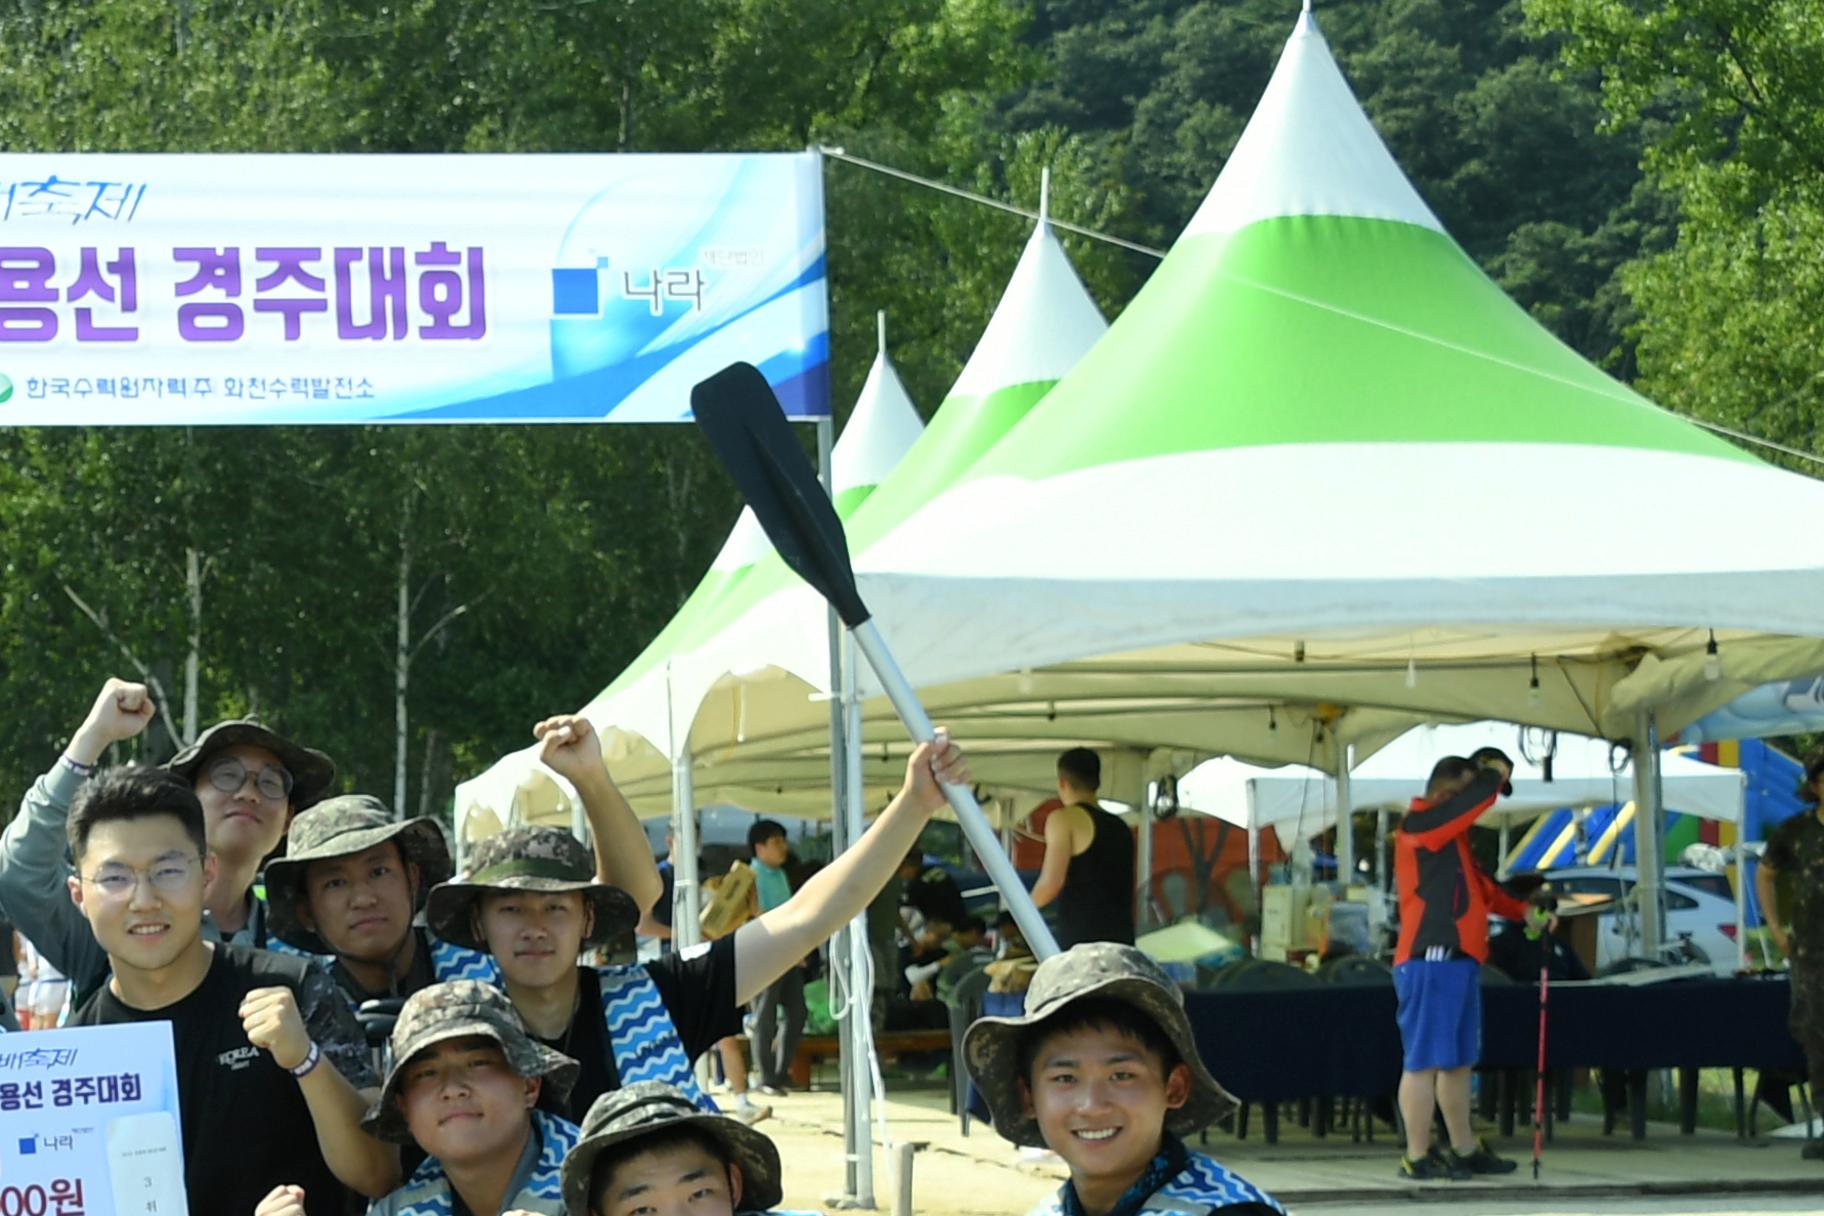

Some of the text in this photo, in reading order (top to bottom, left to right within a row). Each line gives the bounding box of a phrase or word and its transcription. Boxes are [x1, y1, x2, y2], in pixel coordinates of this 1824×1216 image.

[172, 241, 487, 342] 경주대회
[624, 269, 705, 312] 나라
[224, 375, 376, 399] 화천수력발전소
[0, 1080, 43, 1111] 용선
[51, 1073, 142, 1107] 경주대회
[44, 1134, 73, 1151] 나라
[143, 1177, 153, 1188] 3
